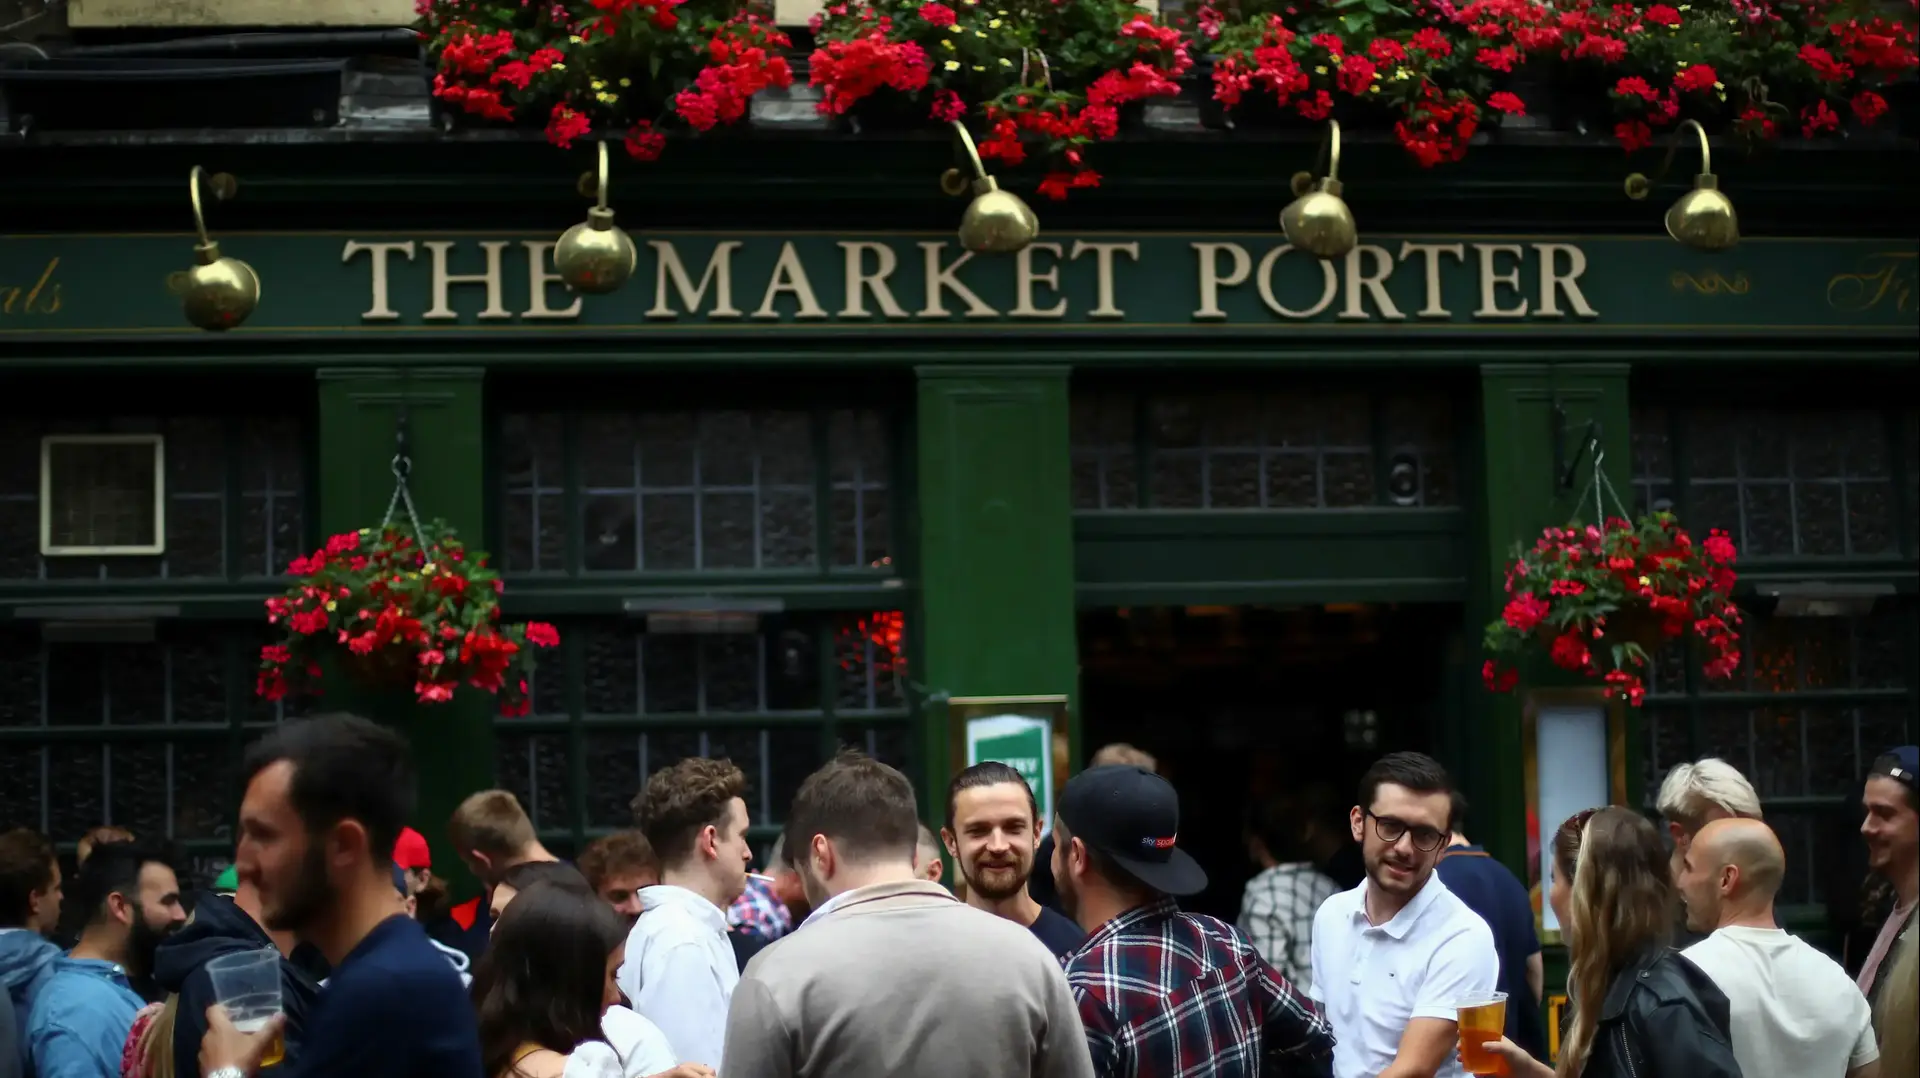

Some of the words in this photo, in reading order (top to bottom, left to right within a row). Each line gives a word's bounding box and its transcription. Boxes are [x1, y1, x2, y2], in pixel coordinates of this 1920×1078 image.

[342, 240, 582, 318] THE
[644, 240, 1140, 317] MARKET
[1190, 241, 1599, 318] PORTER
